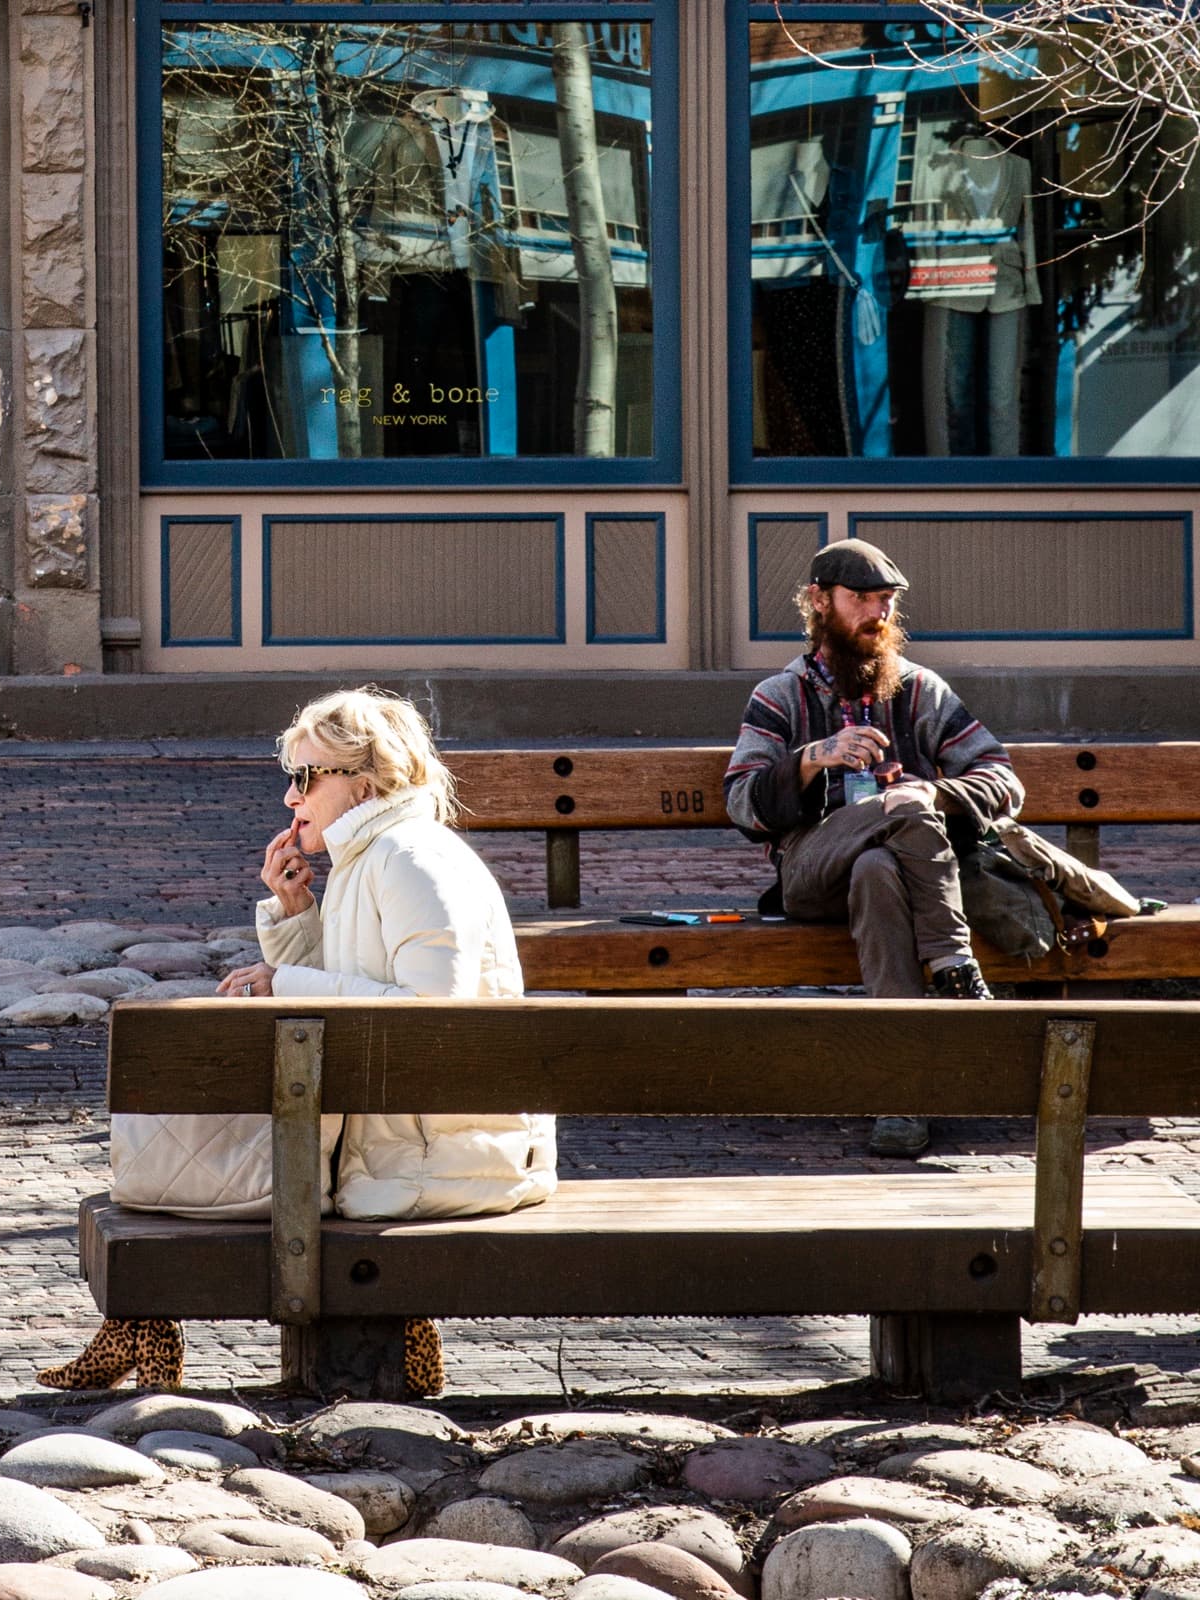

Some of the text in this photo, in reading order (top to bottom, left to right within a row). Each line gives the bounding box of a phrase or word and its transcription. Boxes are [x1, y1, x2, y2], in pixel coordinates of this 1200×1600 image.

[320, 383, 500, 408] rag & bone
[372, 415, 448, 426] NEW YORK
[661, 790, 705, 814] BOB
